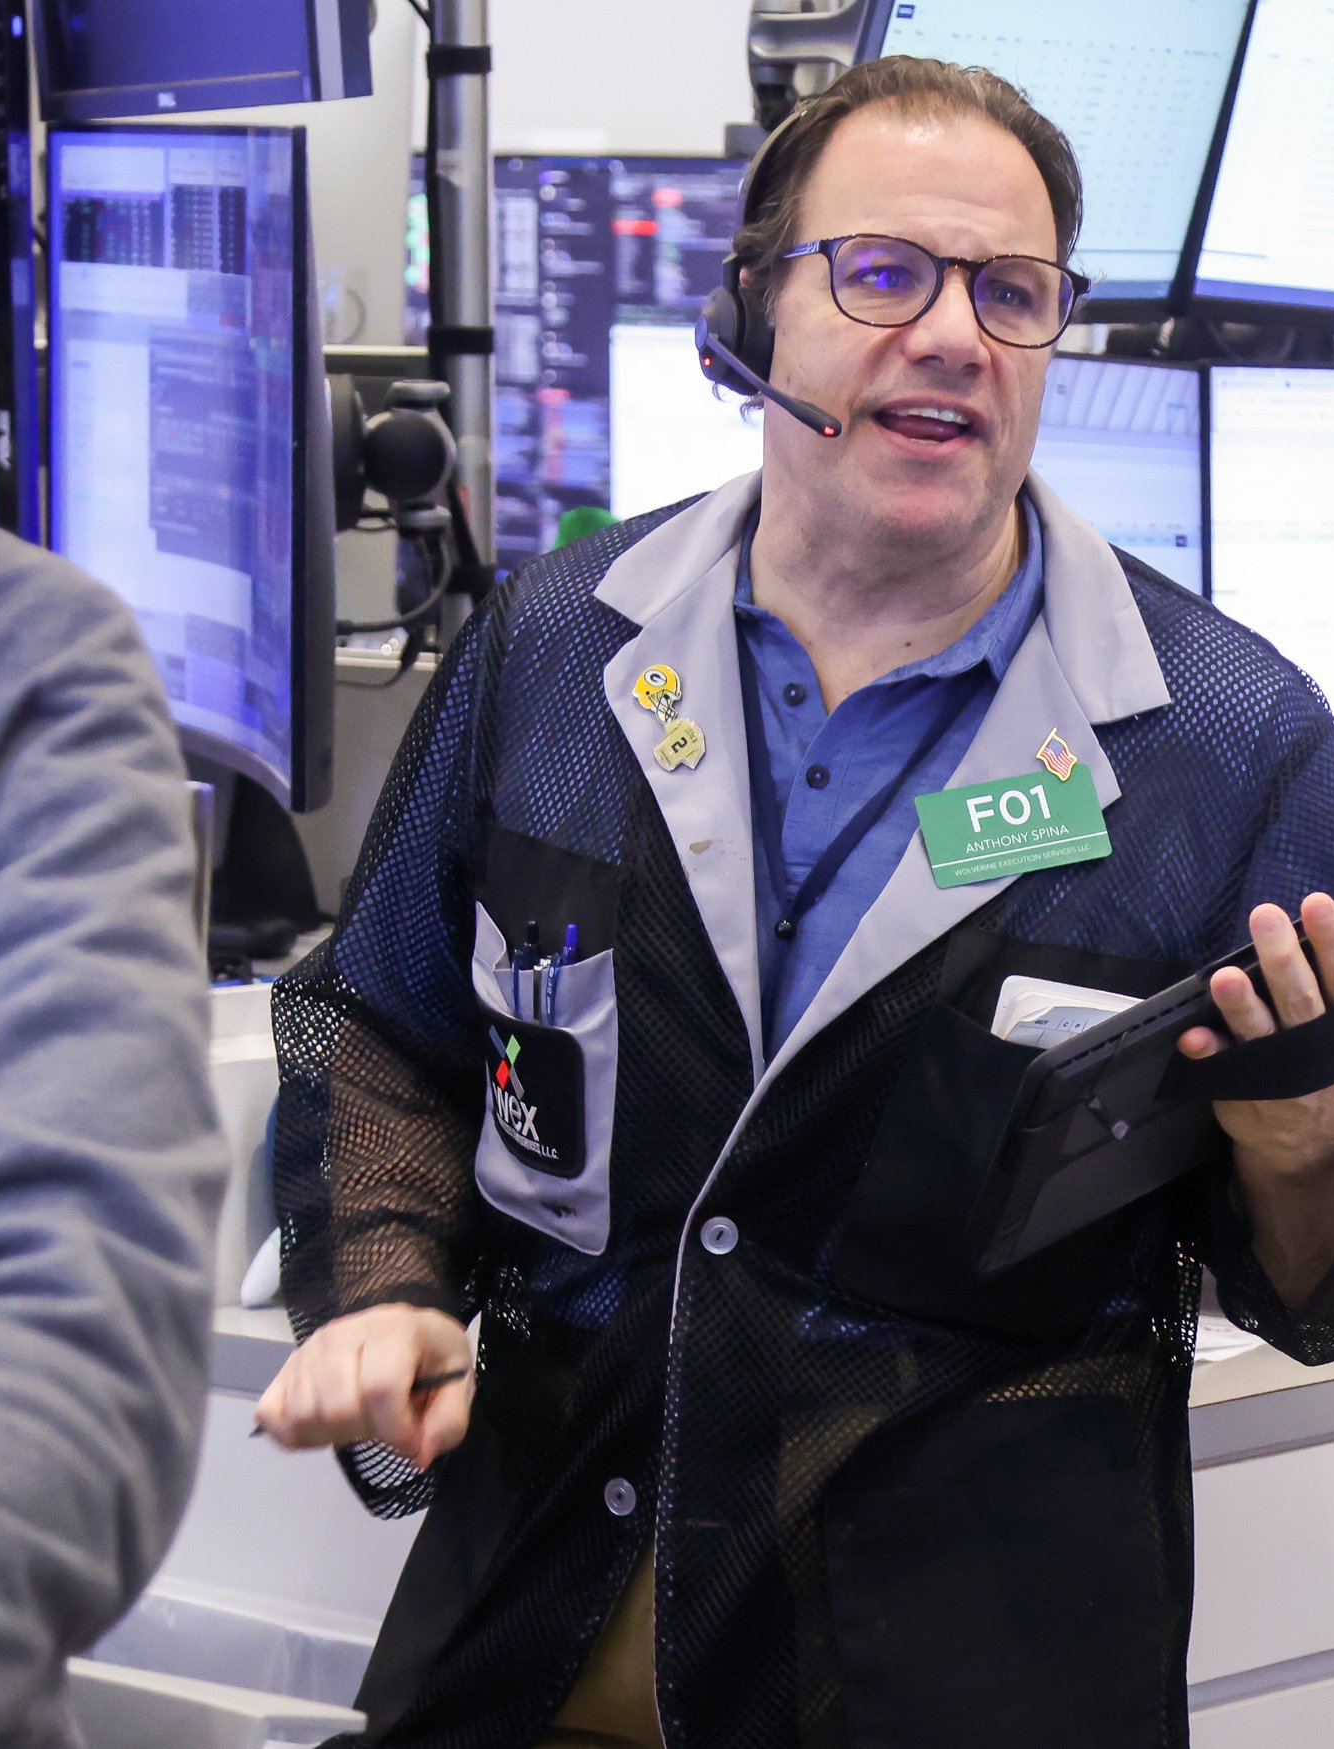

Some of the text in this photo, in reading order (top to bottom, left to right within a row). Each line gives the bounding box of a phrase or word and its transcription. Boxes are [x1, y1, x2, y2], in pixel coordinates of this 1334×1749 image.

[671, 736, 688, 753] 2
[966, 824, 1070, 854] ANTHONY SPINA
[954, 862, 997, 877] WOLVERINE
[998, 854, 1042, 868] EXECUTION
[1043, 847, 1077, 861] SERVICES
